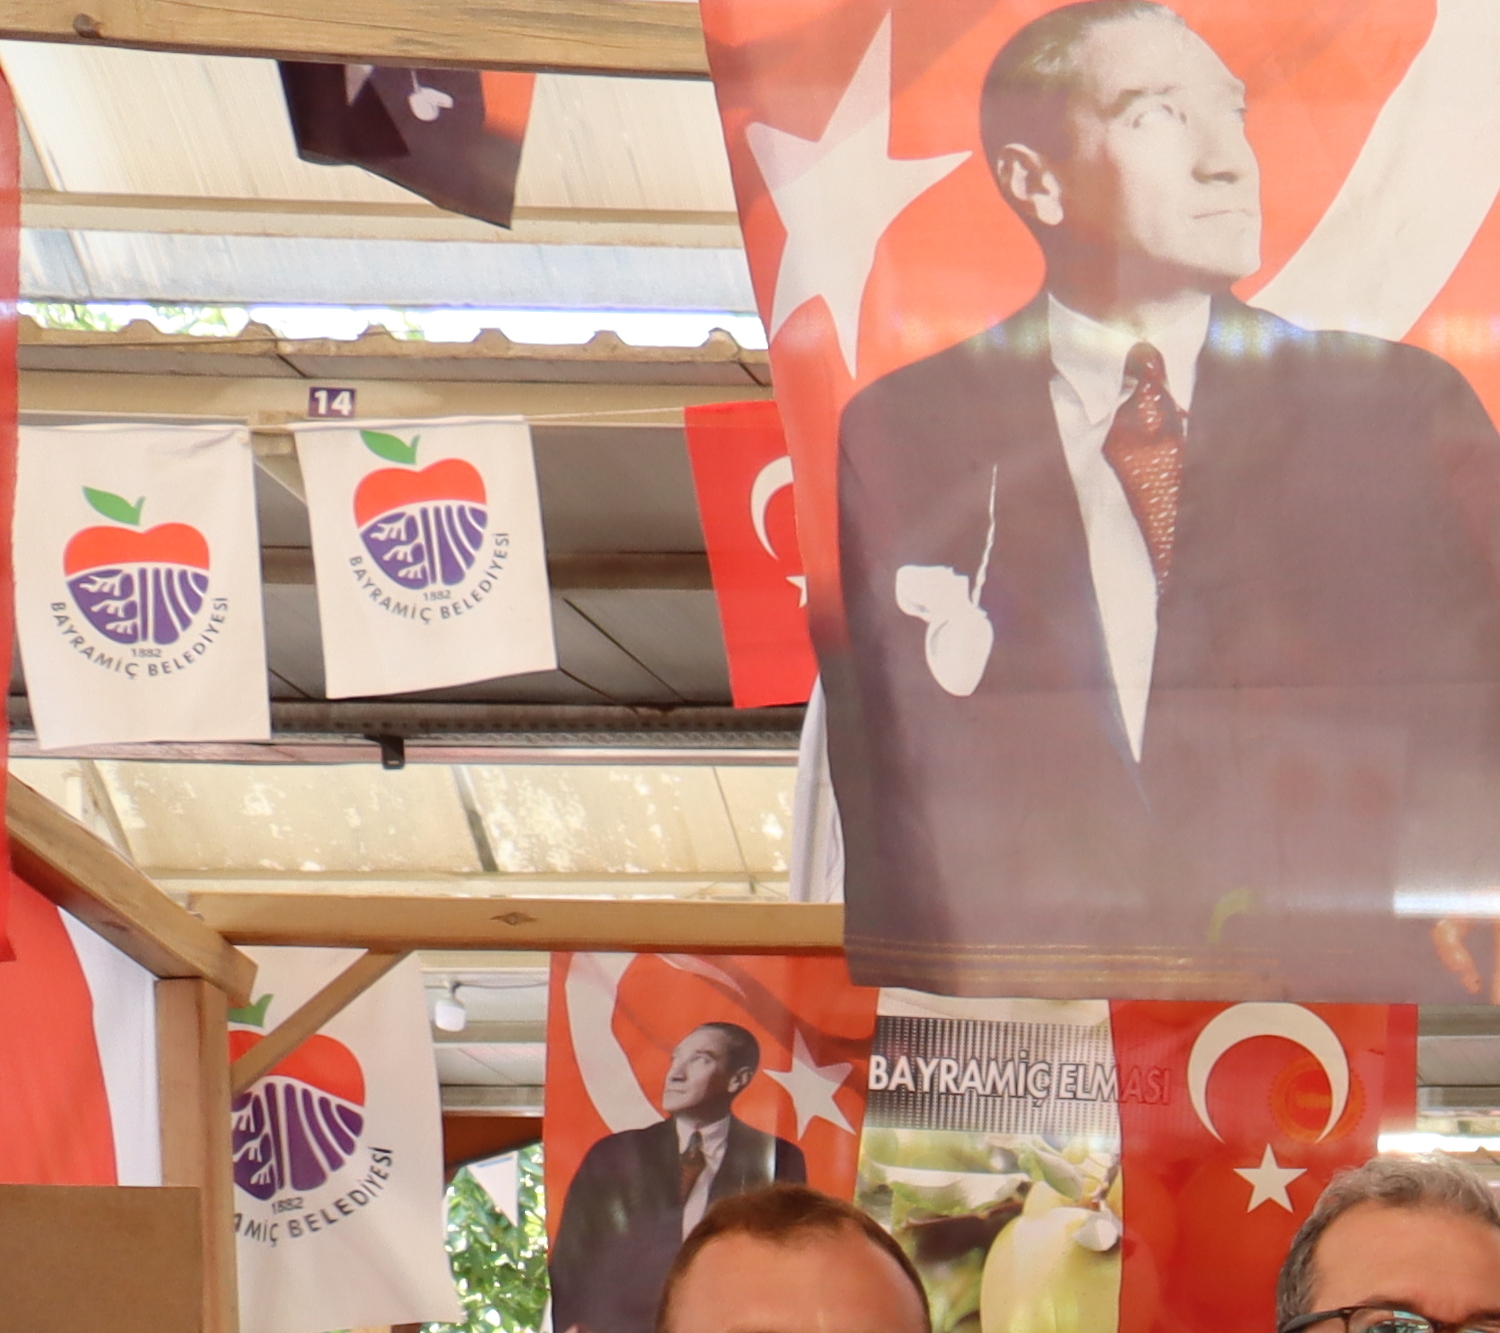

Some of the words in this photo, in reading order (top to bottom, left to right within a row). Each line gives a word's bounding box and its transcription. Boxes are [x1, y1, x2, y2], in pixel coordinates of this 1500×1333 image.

[313, 389, 353, 417] 14
[348, 554, 433, 626] BAYRAMİÇ
[438, 531, 511, 622] BELEDİYESİ
[421, 589, 452, 602] 1882
[50, 600, 140, 679] BAYRAMİÇ
[147, 596, 230, 678] BELEDİYESİ
[130, 647, 163, 659] 1882
[867, 1049, 1051, 1109] BAYRAMİÇ
[287, 1145, 394, 1239] BELEDİYESİ
